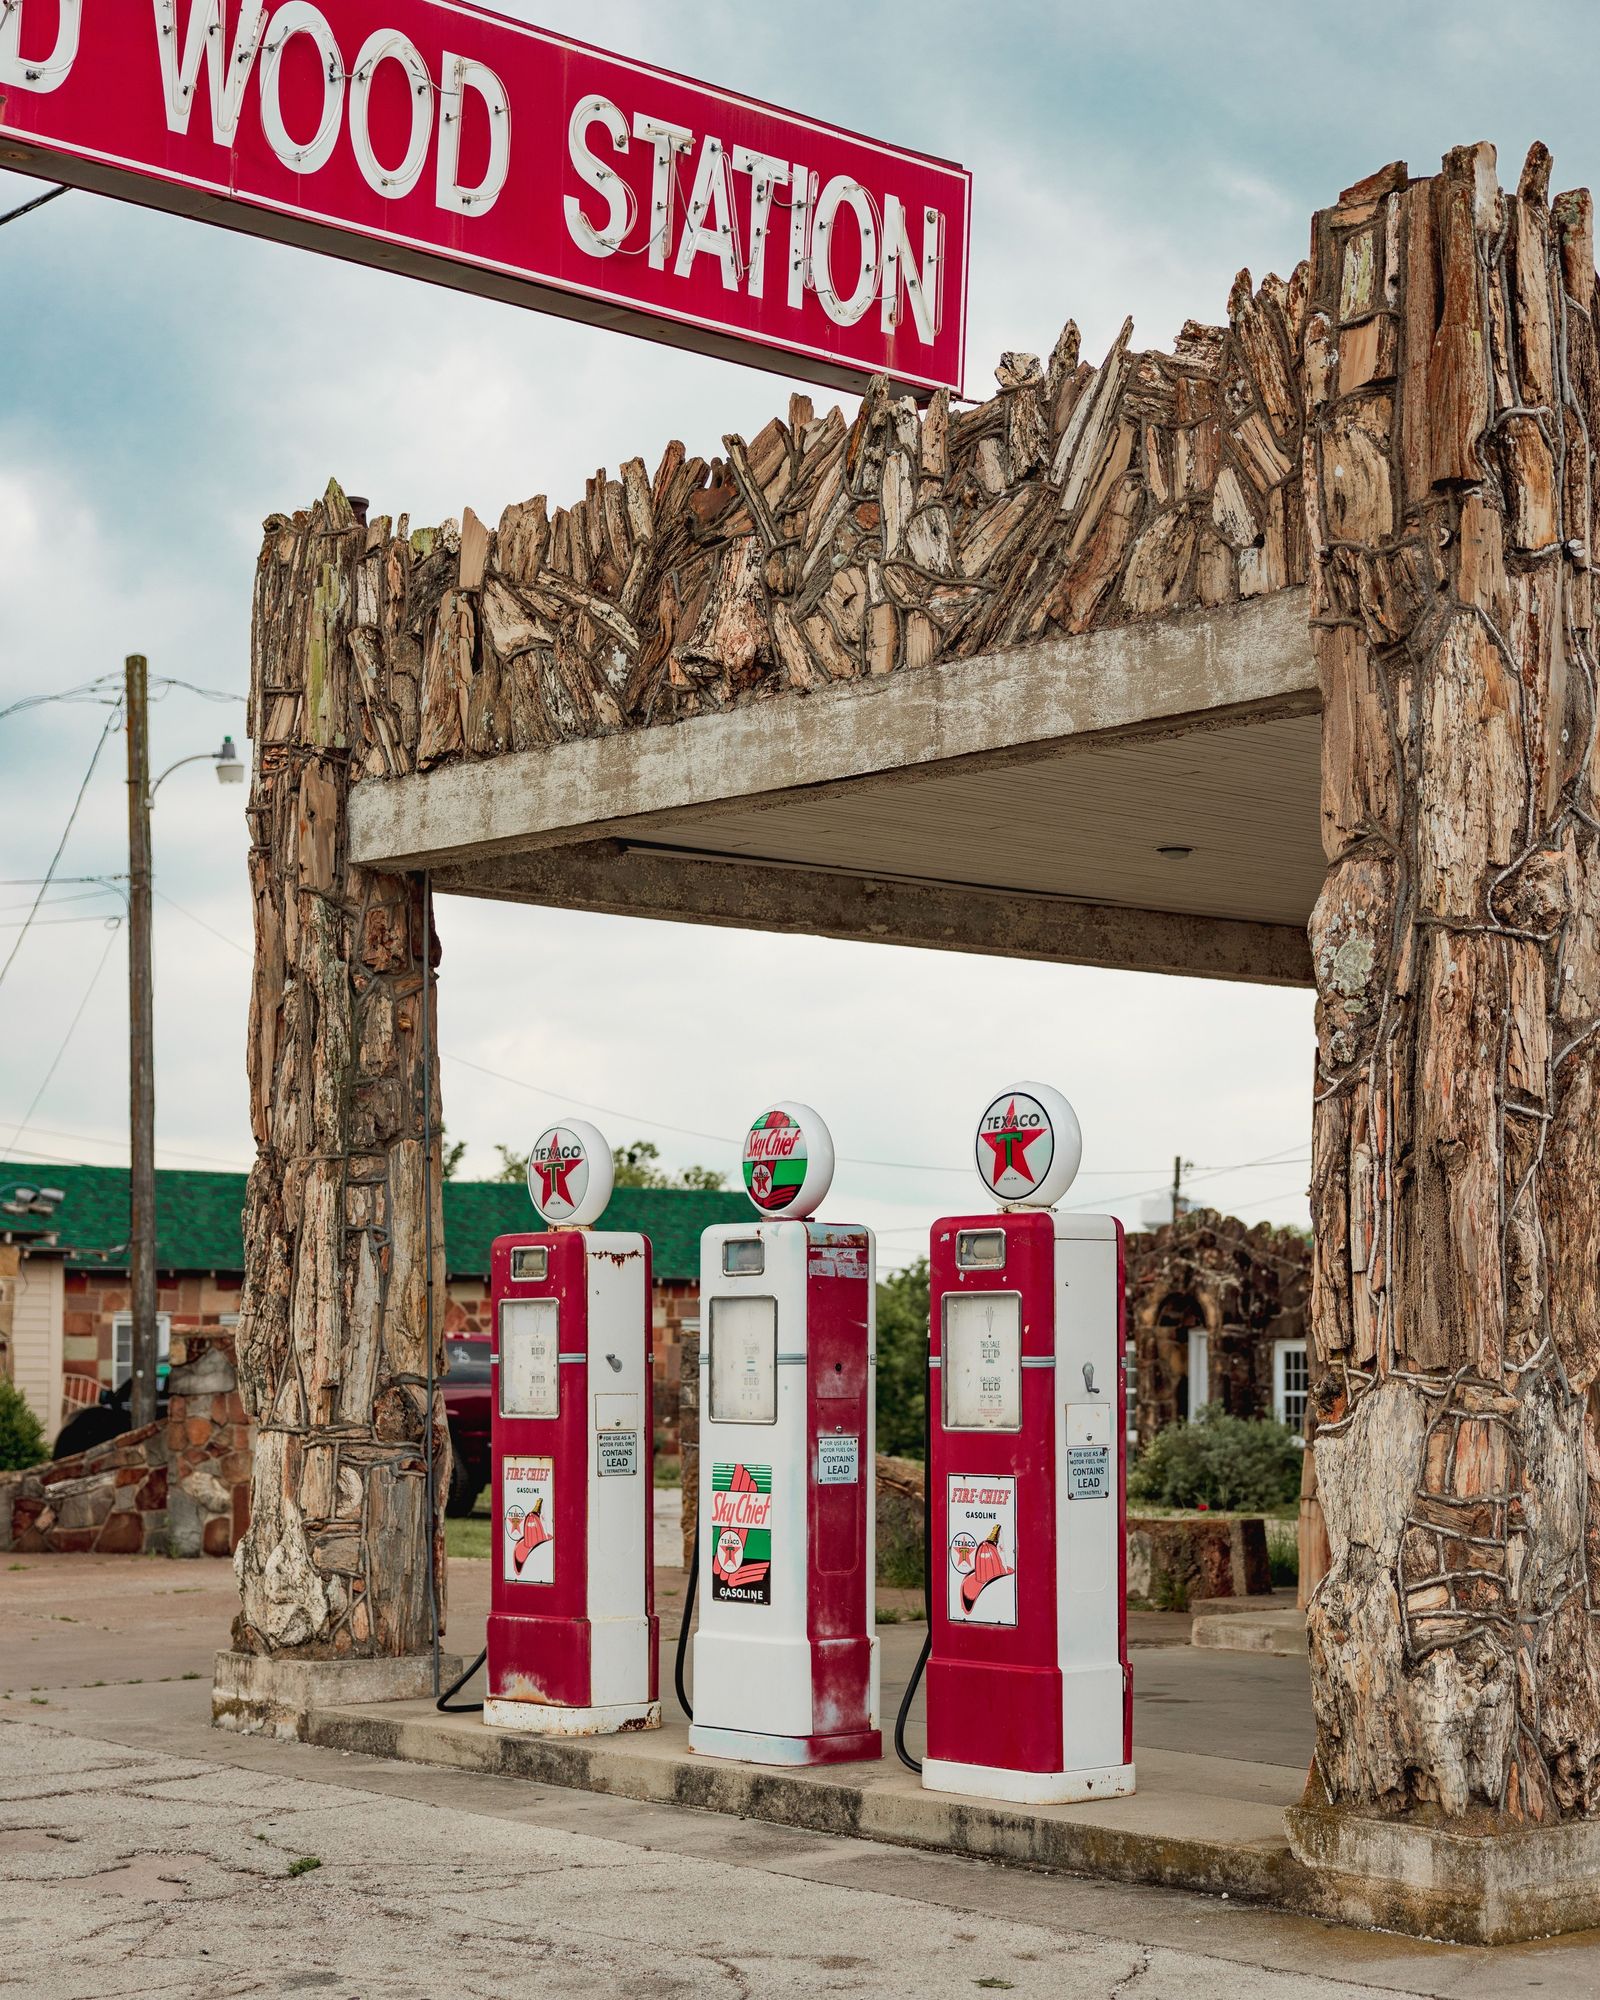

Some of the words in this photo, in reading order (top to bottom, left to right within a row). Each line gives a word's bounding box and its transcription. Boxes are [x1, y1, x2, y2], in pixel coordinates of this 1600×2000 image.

[153, 0, 511, 217] WOOD
[563, 94, 939, 346] STATION
[987, 1113, 1040, 1131] TEXACO
[747, 1130, 767, 1160] Sky
[765, 1128, 801, 1157] Chief
[535, 1145, 582, 1161] TEXACO
[602, 1449, 633, 1457] CONTAINS
[606, 1458, 629, 1467] LEAD
[822, 1455, 855, 1463] CONTAINS
[827, 1465, 850, 1475] LEAD
[1072, 1467, 1105, 1476] CONTAINS
[1077, 1478, 1100, 1488] LEAD
[711, 1492, 737, 1527] Sky
[736, 1493, 771, 1525] Chief
[965, 1511, 997, 1520] GASOLINE
[954, 1539, 976, 1548] TEXACO
[719, 1587, 764, 1600] GASOLINE
